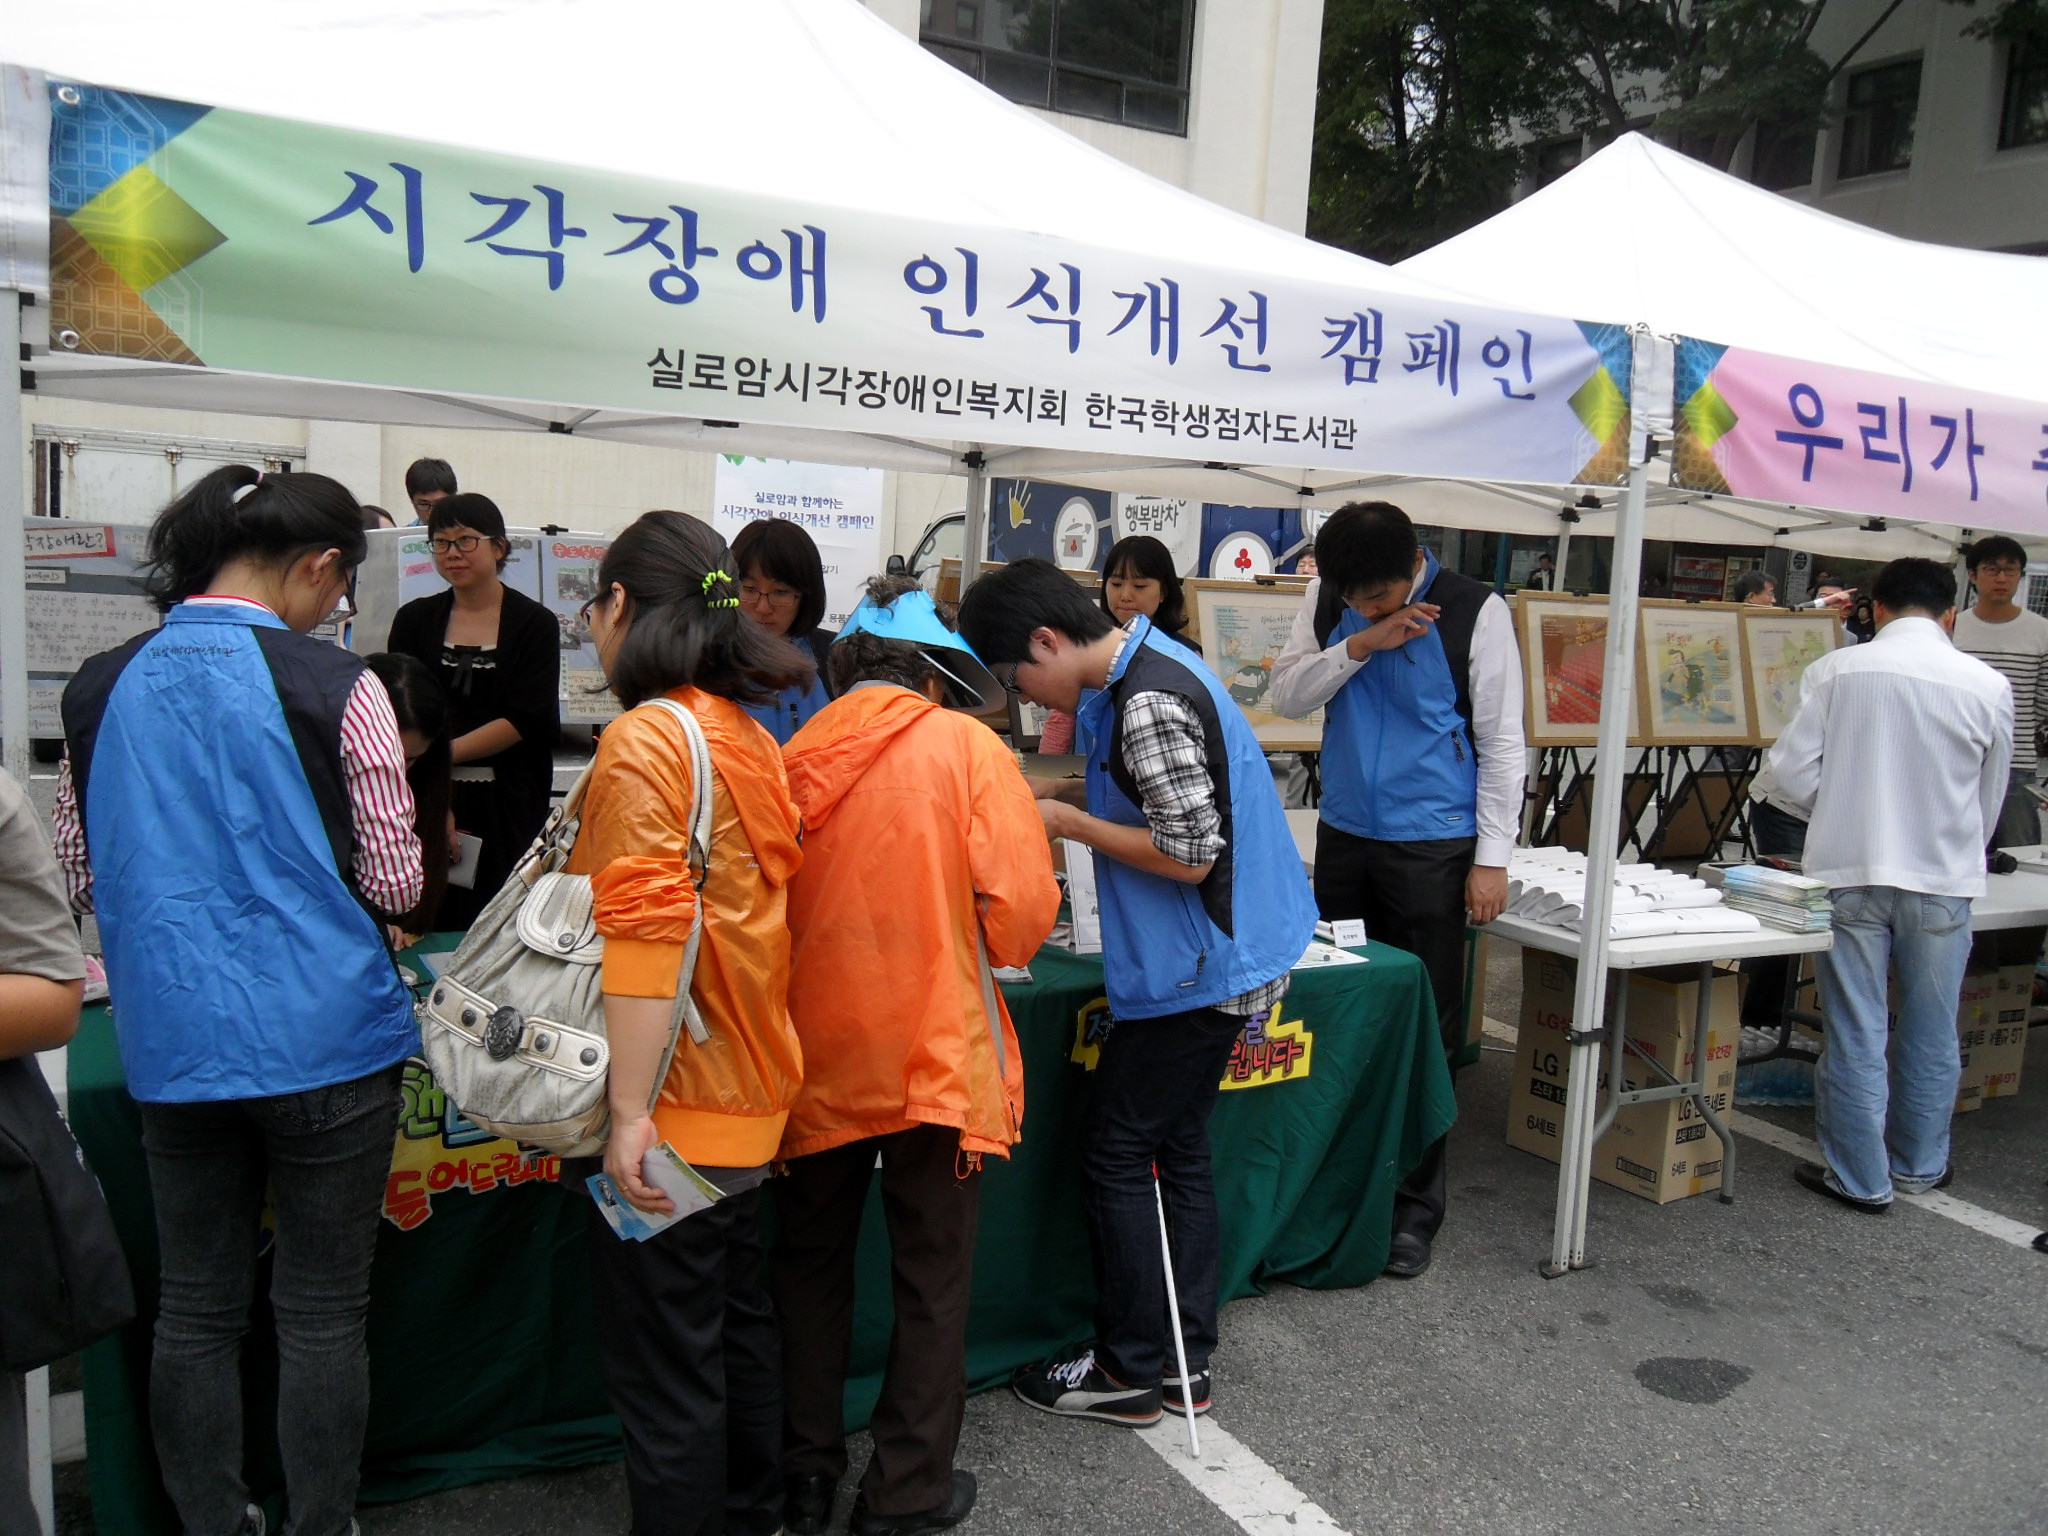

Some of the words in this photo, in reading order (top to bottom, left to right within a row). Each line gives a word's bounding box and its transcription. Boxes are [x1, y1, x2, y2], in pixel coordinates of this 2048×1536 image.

[306, 161, 828, 324] 시각장애
[902, 246, 1272, 374] 인식개선
[1320, 307, 1537, 401] 캠페인
[646, 346, 1068, 427] 실로암시각장애인복지회
[1085, 391, 1359, 451] 한국학생점자도서관
[1775, 382, 1986, 502] 우리가
[755, 491, 798, 507] 실로암과
[801, 495, 844, 510] 함께하는
[721, 504, 774, 521] 시각장애
[835, 514, 876, 530] 캠페인
[1125, 504, 1179, 532] 행복밥차
[1532, 1049, 1559, 1078] LG
[1678, 1100, 1692, 1122] LG
[1526, 1114, 1557, 1138] 6세트
